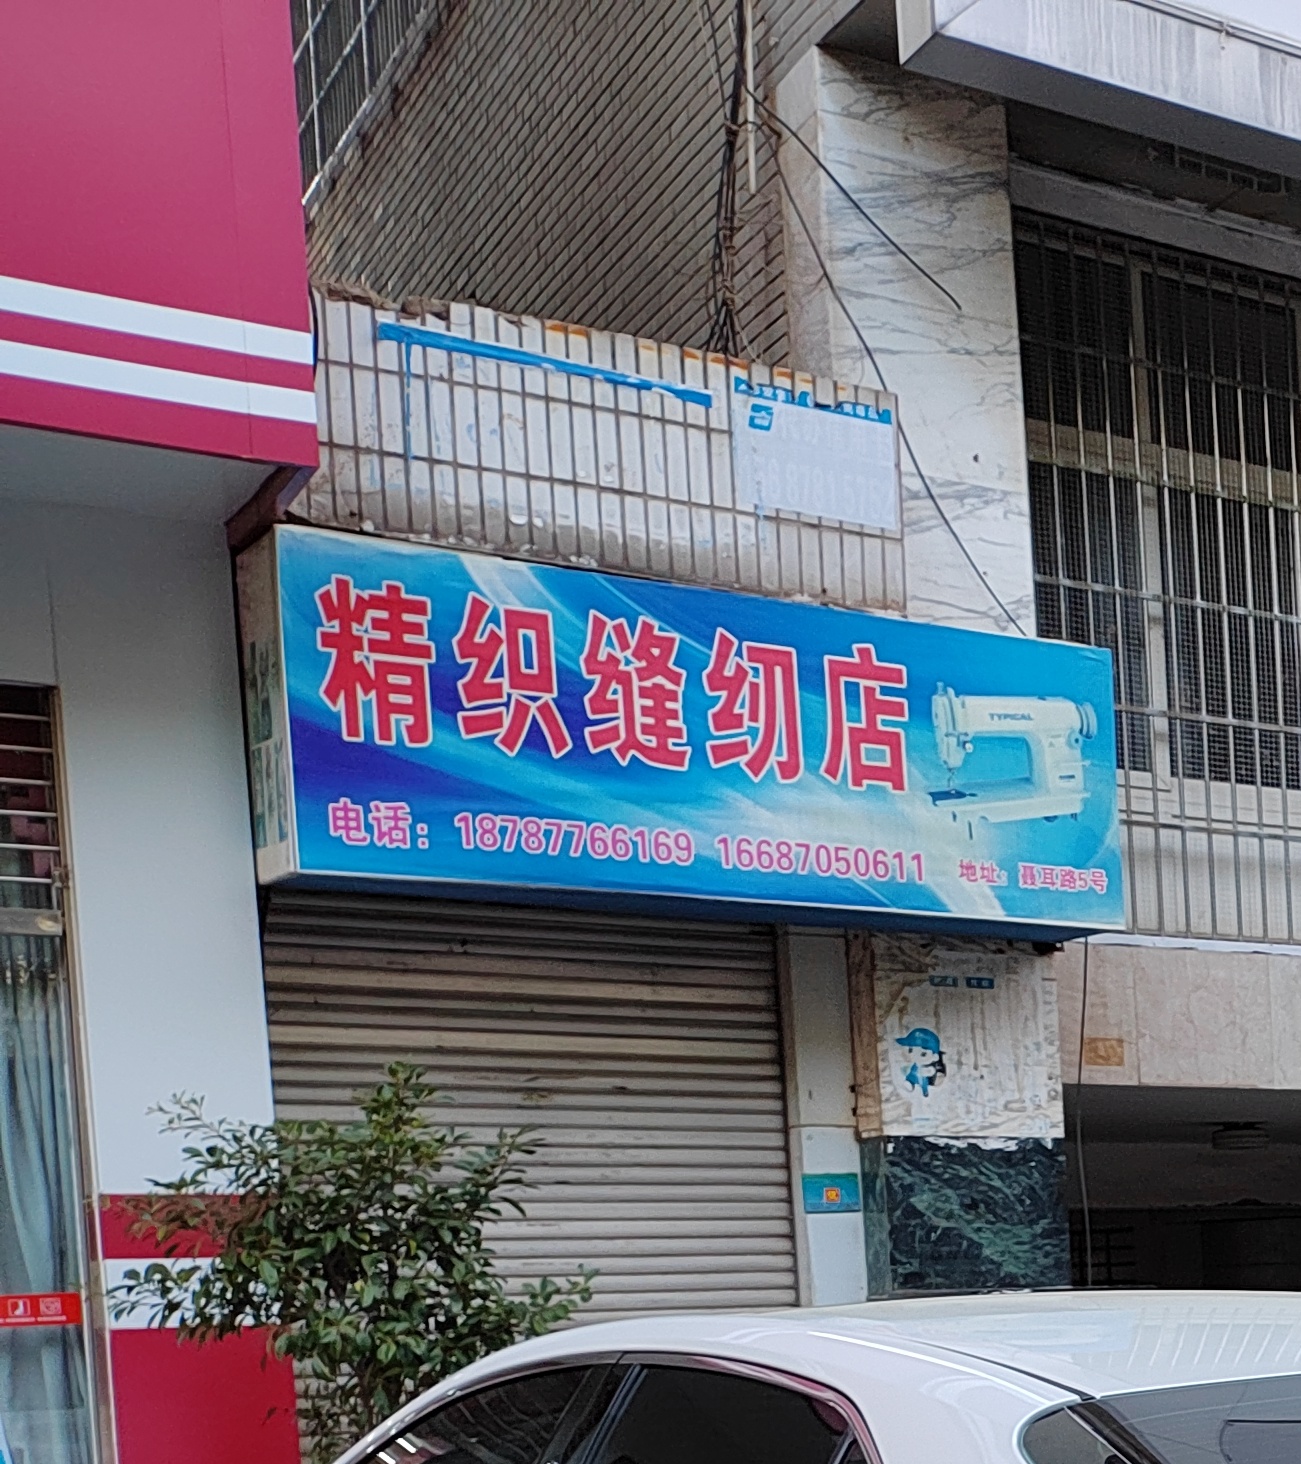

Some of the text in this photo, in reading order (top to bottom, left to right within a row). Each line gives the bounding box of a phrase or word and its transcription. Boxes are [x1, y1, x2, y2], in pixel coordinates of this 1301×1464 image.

[313, 574, 909, 793] 精织缝纫店
[715, 836, 925, 883] 16687050611
